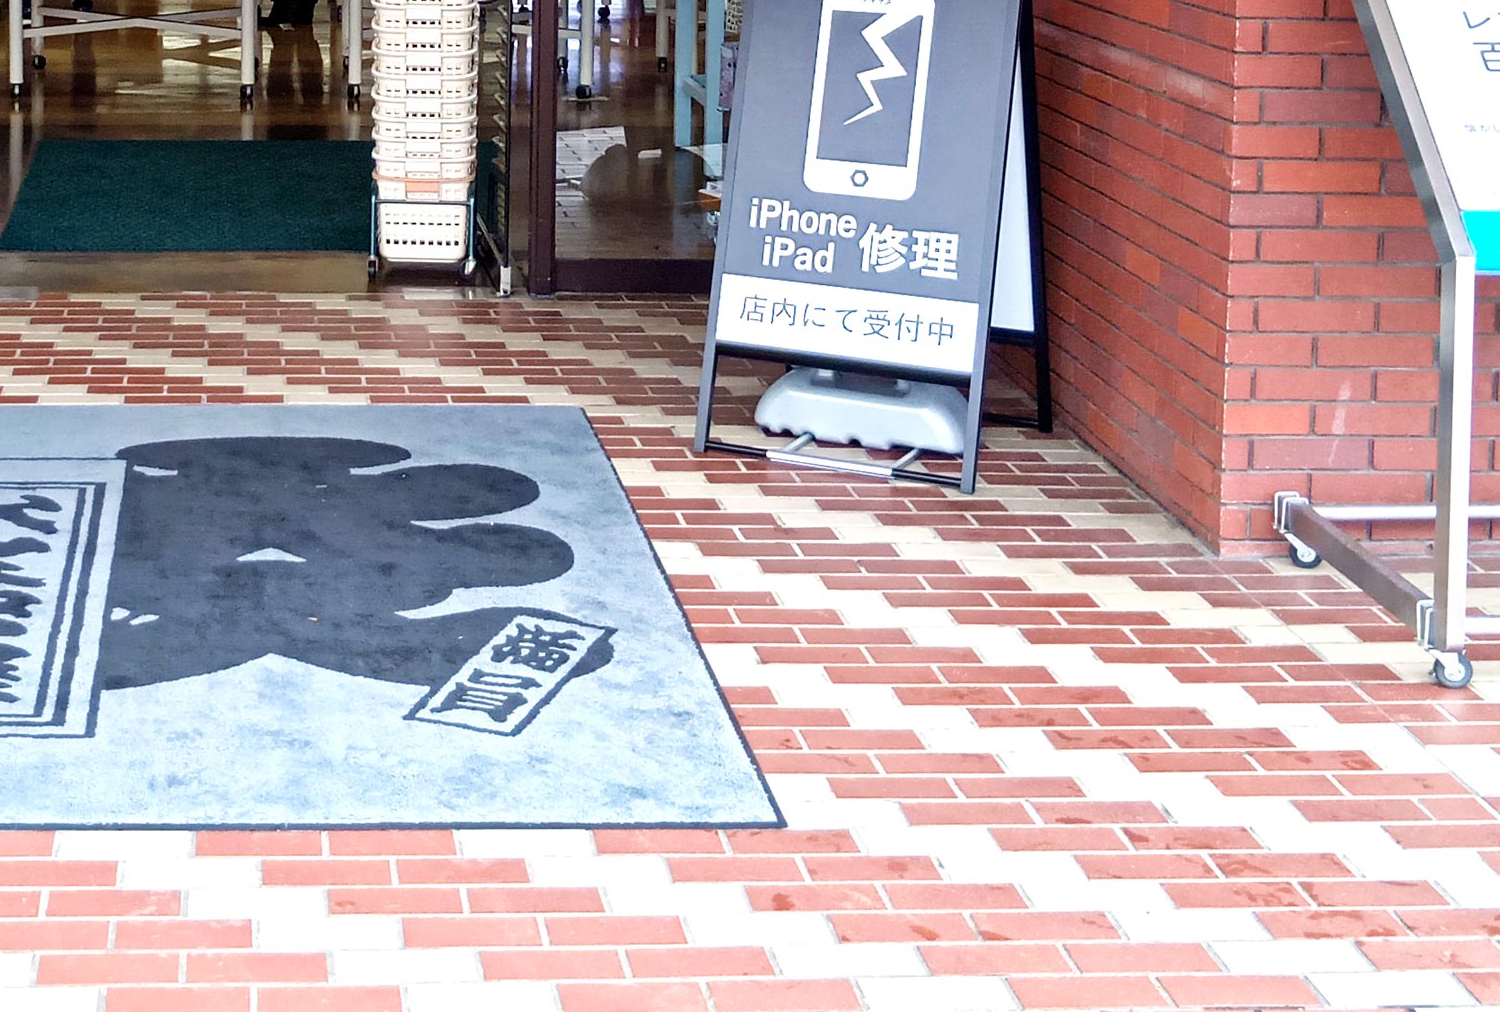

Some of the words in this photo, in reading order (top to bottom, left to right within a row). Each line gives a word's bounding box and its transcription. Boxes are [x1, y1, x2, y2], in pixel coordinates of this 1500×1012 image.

[1463, 10, 1500, 29] レ
[749, 197, 857, 238] iPhone
[762, 237, 835, 274] iPad
[858, 222, 960, 281] 修理
[739, 294, 955, 348] 店内にて受付中
